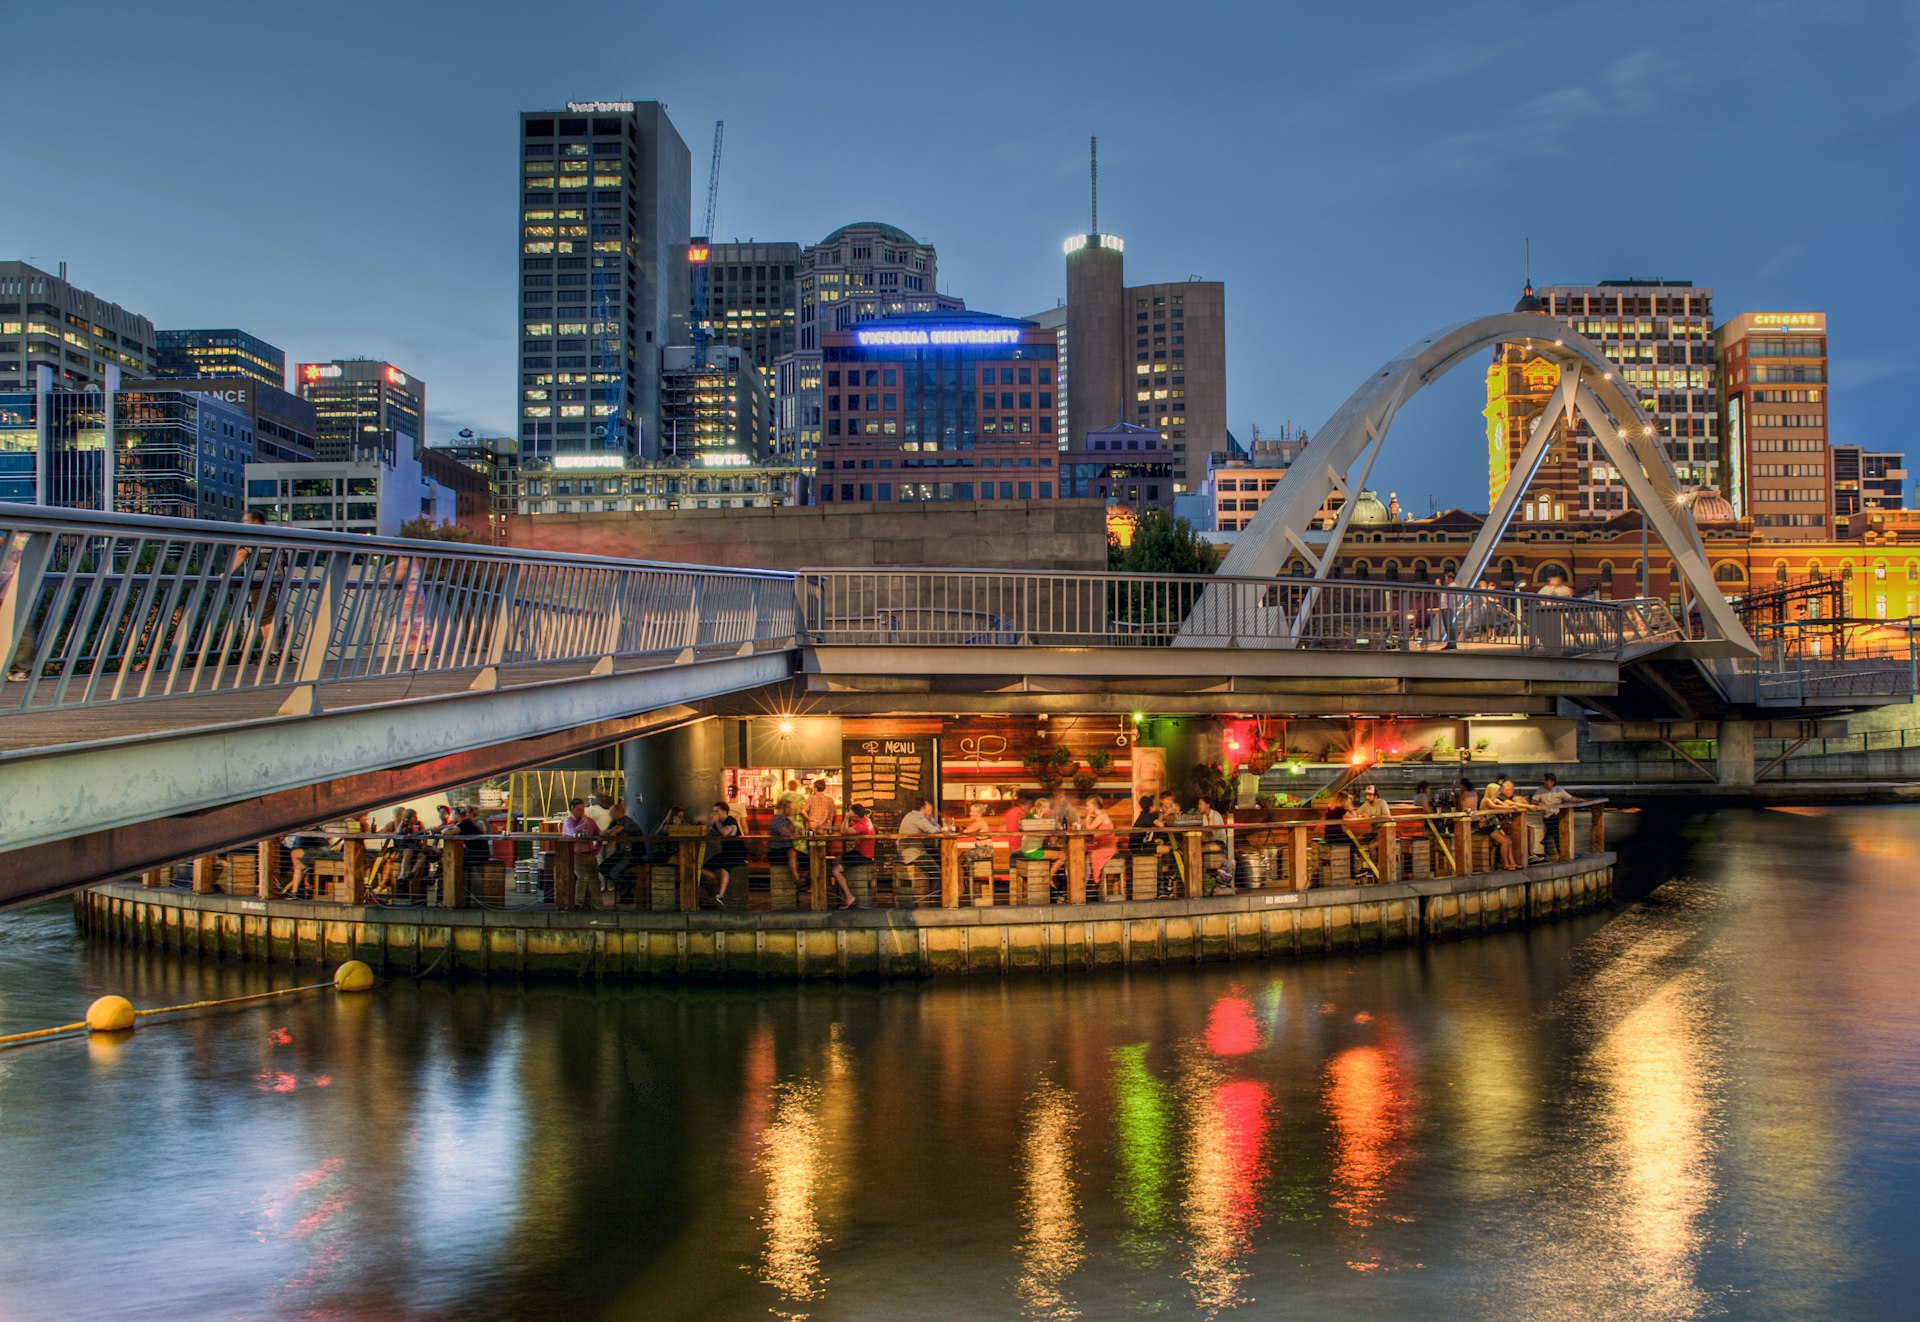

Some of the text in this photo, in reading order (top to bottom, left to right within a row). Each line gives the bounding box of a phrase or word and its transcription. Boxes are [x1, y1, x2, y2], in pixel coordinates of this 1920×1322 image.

[1754, 315, 1815, 325] CITIGATE
[858, 330, 1019, 344] VICTORIA UNIVERSITY
[704, 454, 750, 466] HOTEL
